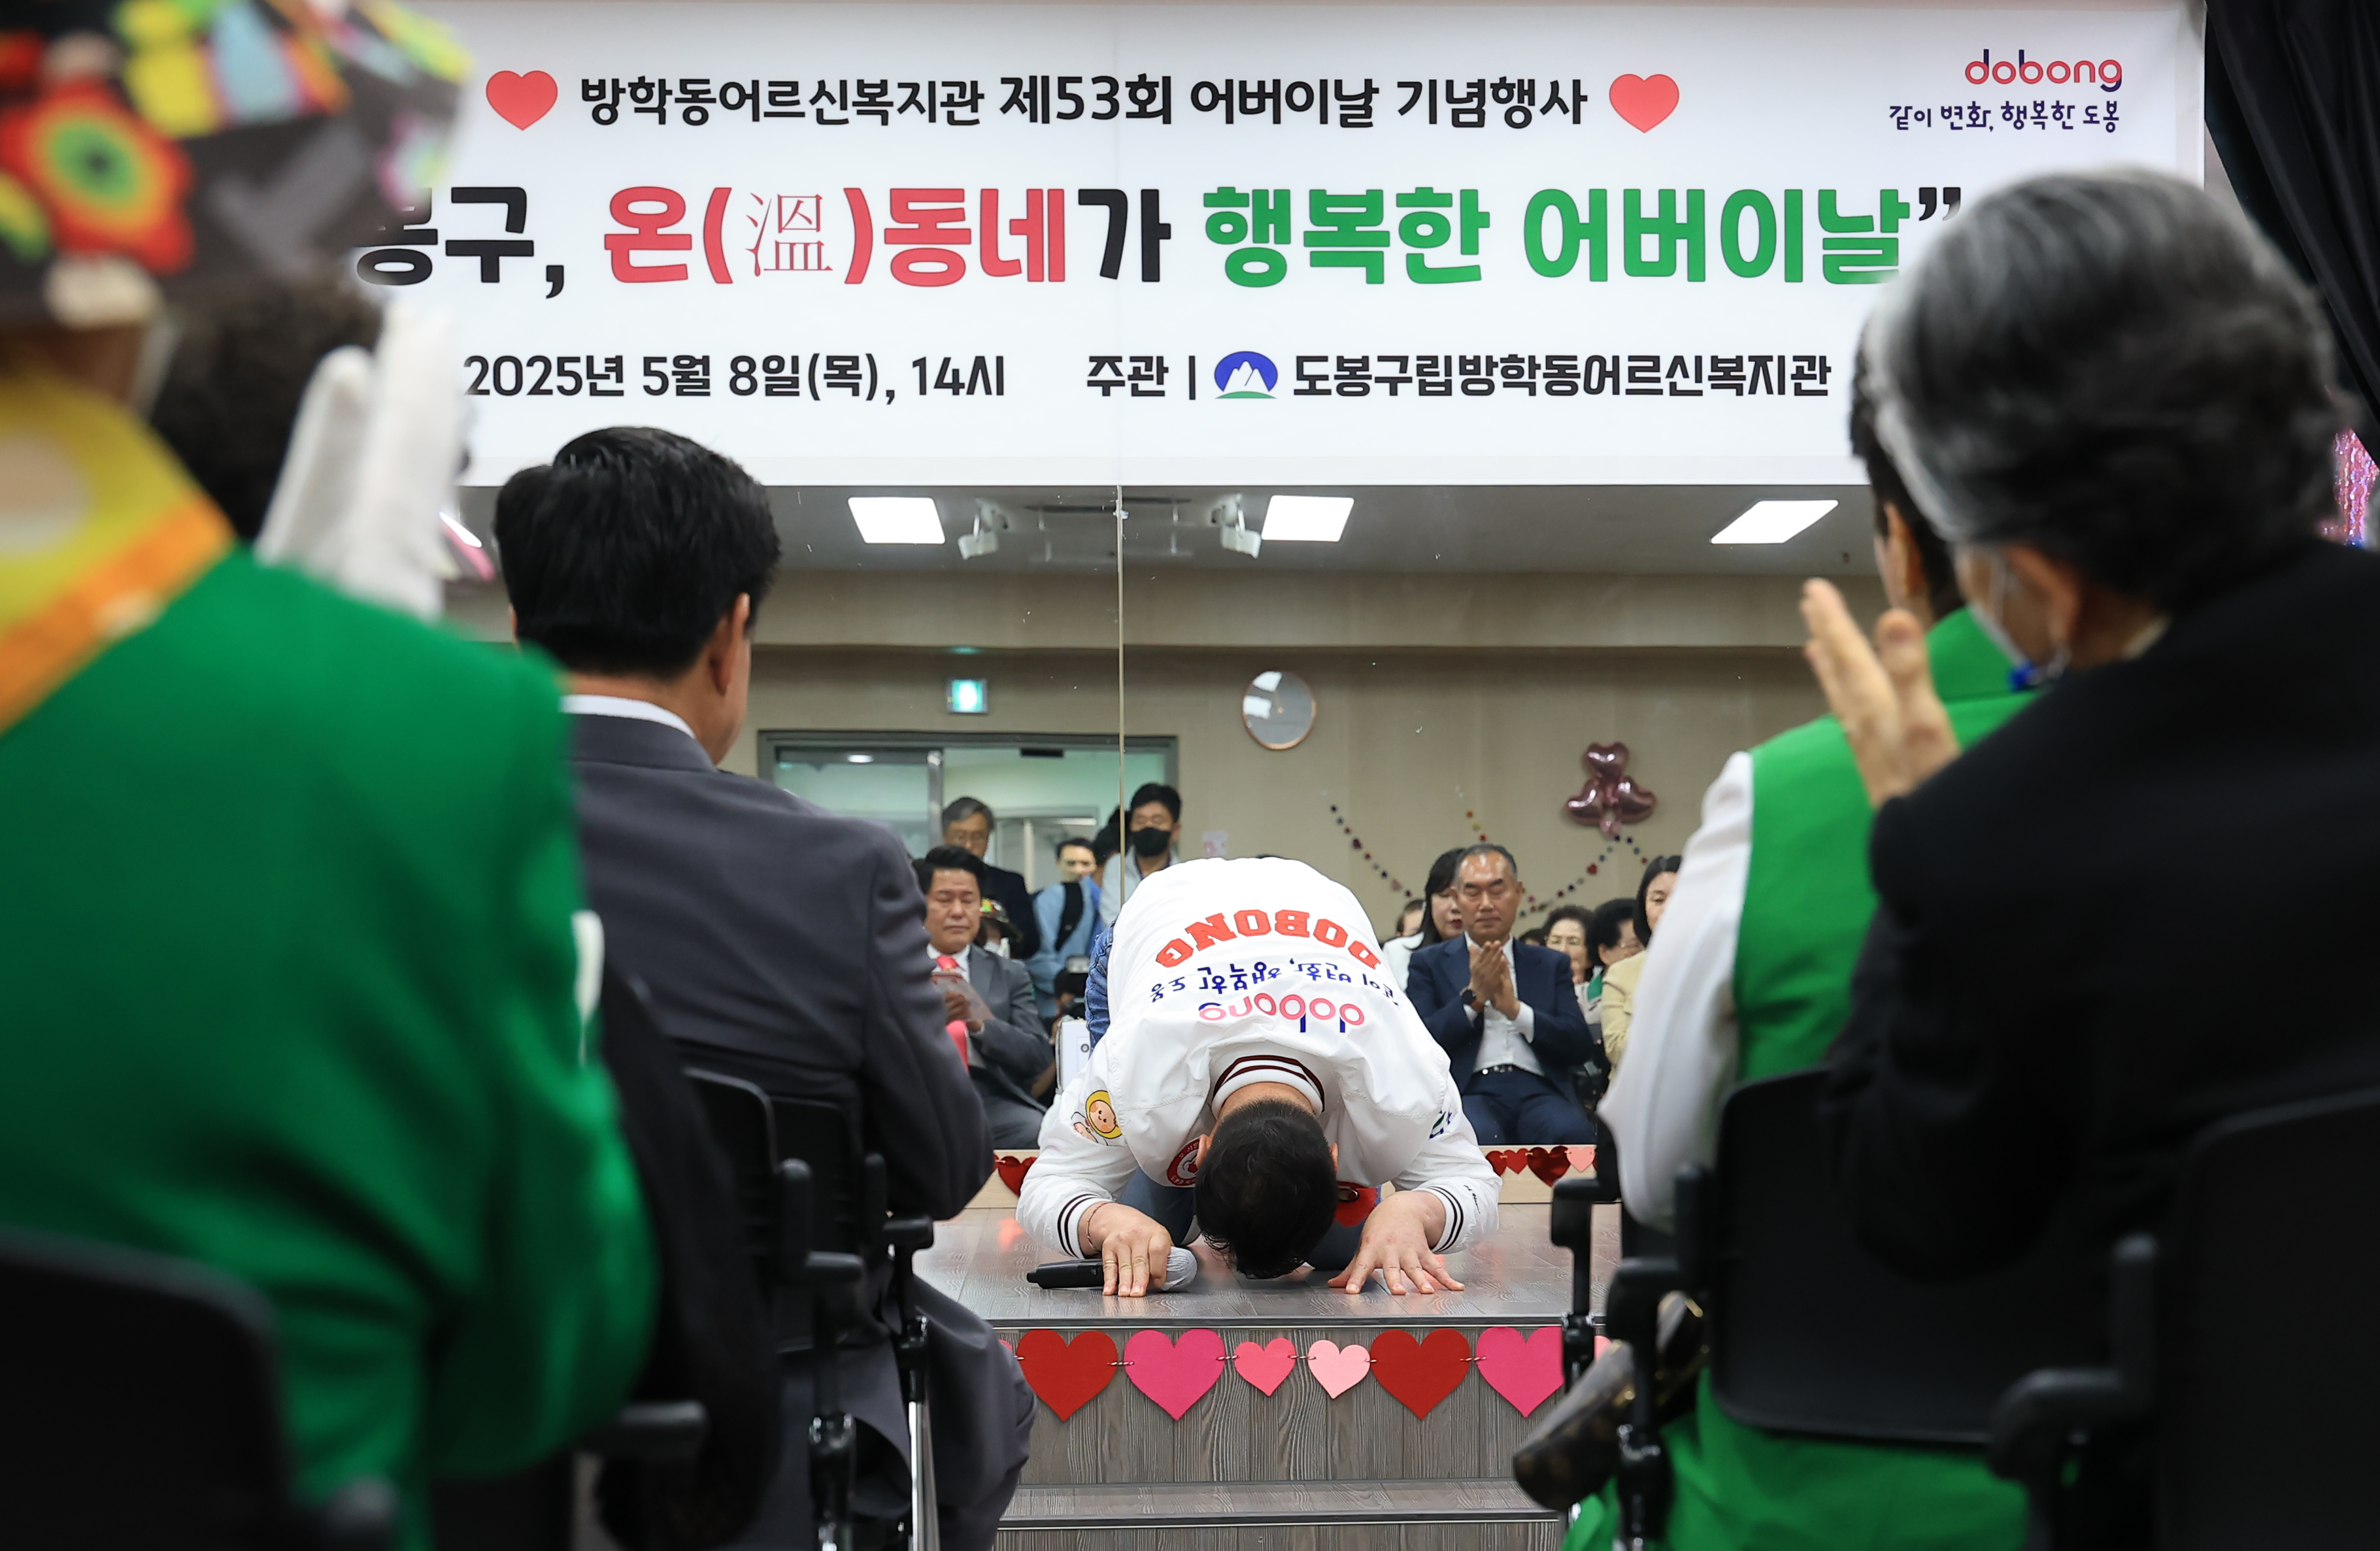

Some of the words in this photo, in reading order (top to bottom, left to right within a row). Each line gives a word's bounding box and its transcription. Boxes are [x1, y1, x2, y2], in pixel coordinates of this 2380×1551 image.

[1964, 49, 2123, 93] dobong
[581, 75, 985, 127] 방학동어르신복지관
[999, 73, 1172, 125] 제53회
[1190, 78, 1380, 129] 어버이날
[1397, 75, 1588, 129] 기념행사
[1889, 105, 1932, 131] 같이
[1940, 100, 1994, 132] 변화,
[2000, 99, 2075, 131] 행복한
[2083, 100, 2120, 133] 도봉
[603, 186, 1172, 288] 온(溫)동네가
[1203, 186, 1490, 288] 행복한
[463, 354, 625, 397] 2025년
[643, 354, 711, 397] 5월
[729, 352, 896, 405] 8일(목),
[912, 355, 1005, 396] 14시
[1086, 355, 1169, 397] 주관
[1293, 354, 1832, 398] 도봉구립방학동어르신복지관
[1156, 909, 1381, 970] DOBONG
[1149, 975, 1186, 1003] 도봉
[1197, 961, 1282, 995] 행복한
[1288, 958, 1351, 983] 변화,
[1198, 993, 1365, 1033] dobong
